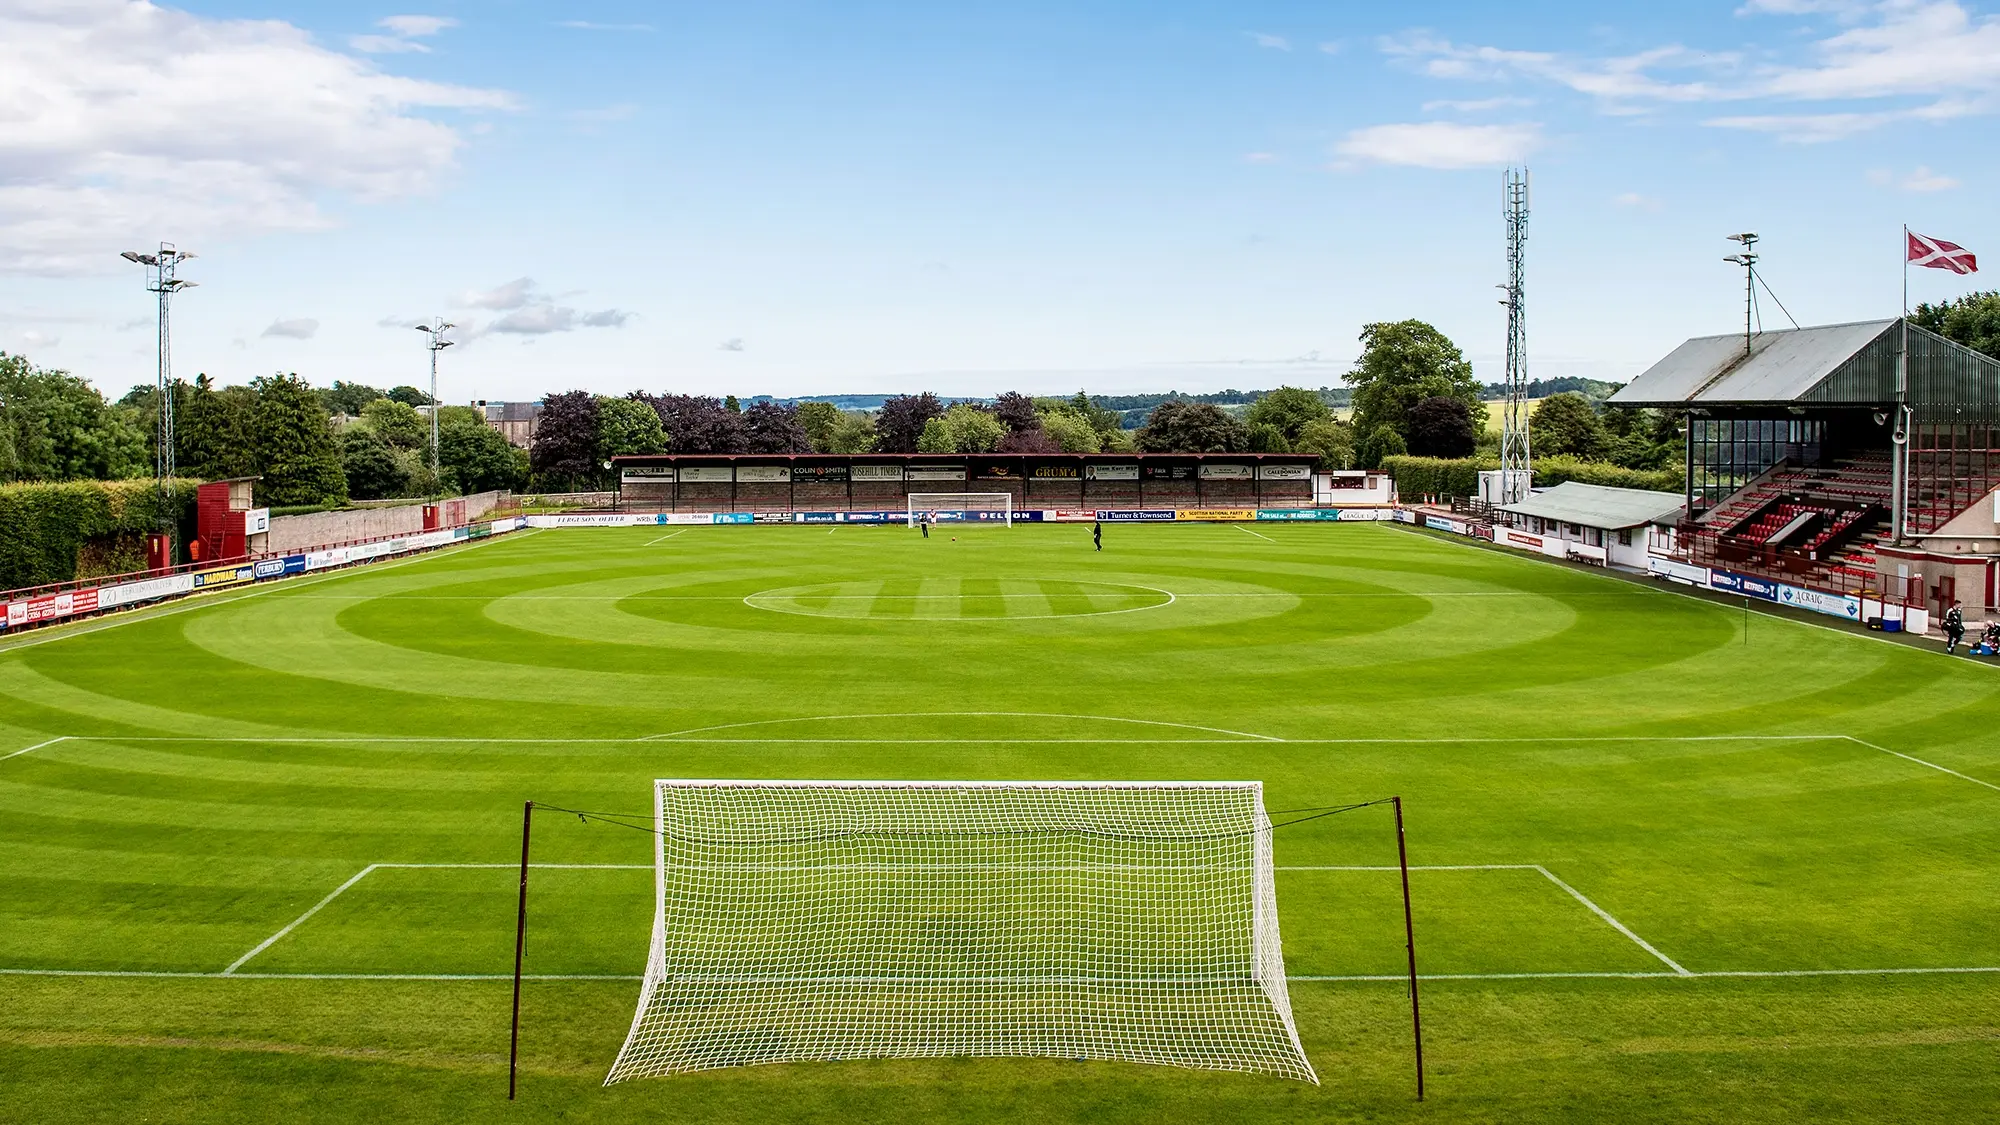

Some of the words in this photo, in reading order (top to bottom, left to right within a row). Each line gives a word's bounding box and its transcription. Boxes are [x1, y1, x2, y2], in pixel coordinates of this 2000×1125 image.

[851, 466, 878, 476] ROSEHILL
[1140, 511, 1172, 519] Townsend
[204, 570, 237, 585] HARDWARE
[1801, 592, 1823, 604] CRAIG
